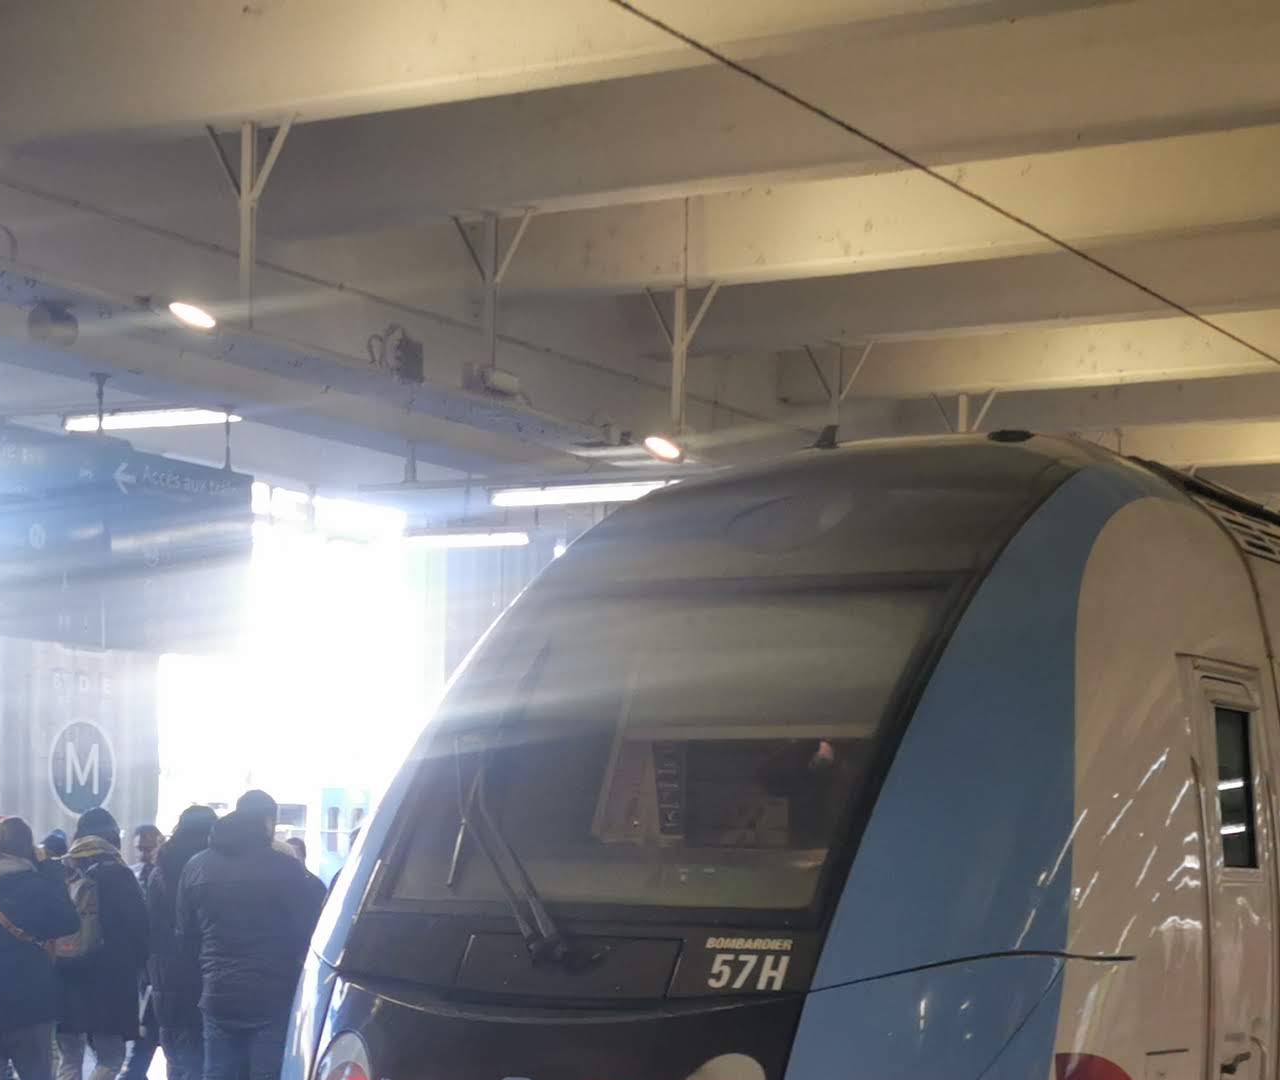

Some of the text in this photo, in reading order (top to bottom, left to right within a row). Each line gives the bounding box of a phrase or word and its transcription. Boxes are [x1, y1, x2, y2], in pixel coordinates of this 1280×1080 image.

[66, 741, 100, 796] M
[705, 937, 793, 951] BOMBARDIER
[707, 953, 791, 992] 57H
